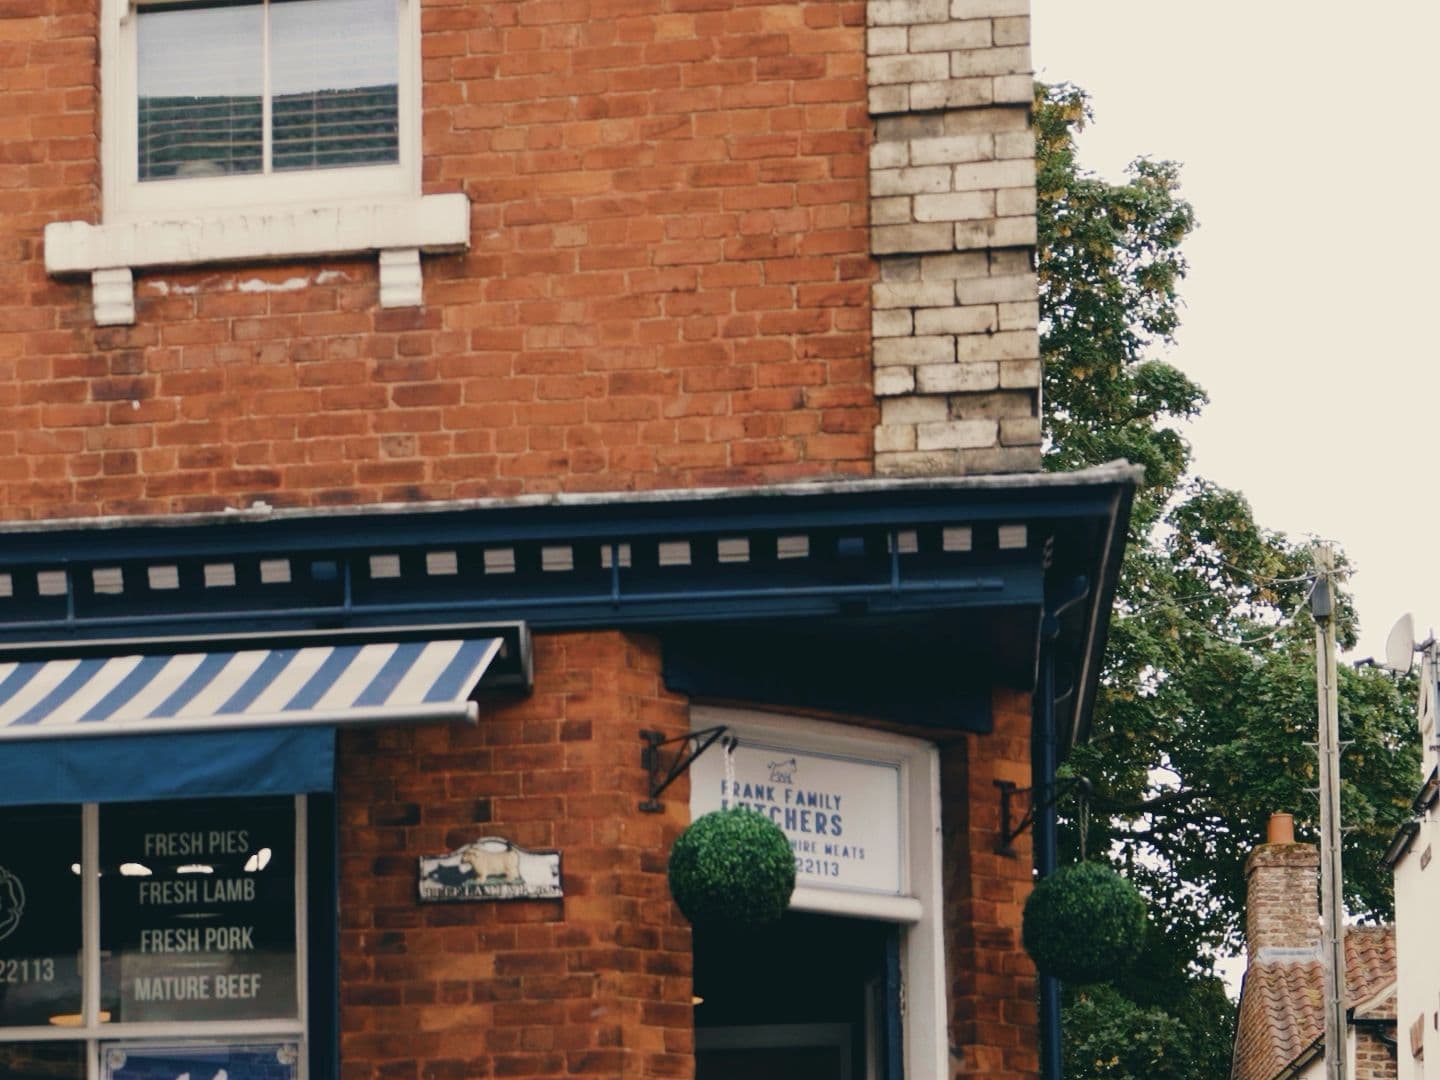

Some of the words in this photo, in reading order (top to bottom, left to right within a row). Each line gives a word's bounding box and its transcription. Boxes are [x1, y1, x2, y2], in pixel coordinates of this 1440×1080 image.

[721, 780, 775, 802] FRANK
[784, 788, 842, 810] FAMILY
[144, 832, 202, 856] FRESH
[209, 830, 249, 854] PIES
[825, 844, 864, 859] MEATS
[140, 881, 198, 904] FRESH
[203, 878, 256, 902] LAMB
[140, 930, 200, 953] FRESH
[205, 926, 255, 950] PORK
[134, 976, 209, 1000] MATURE
[215, 974, 261, 998] BEEF
